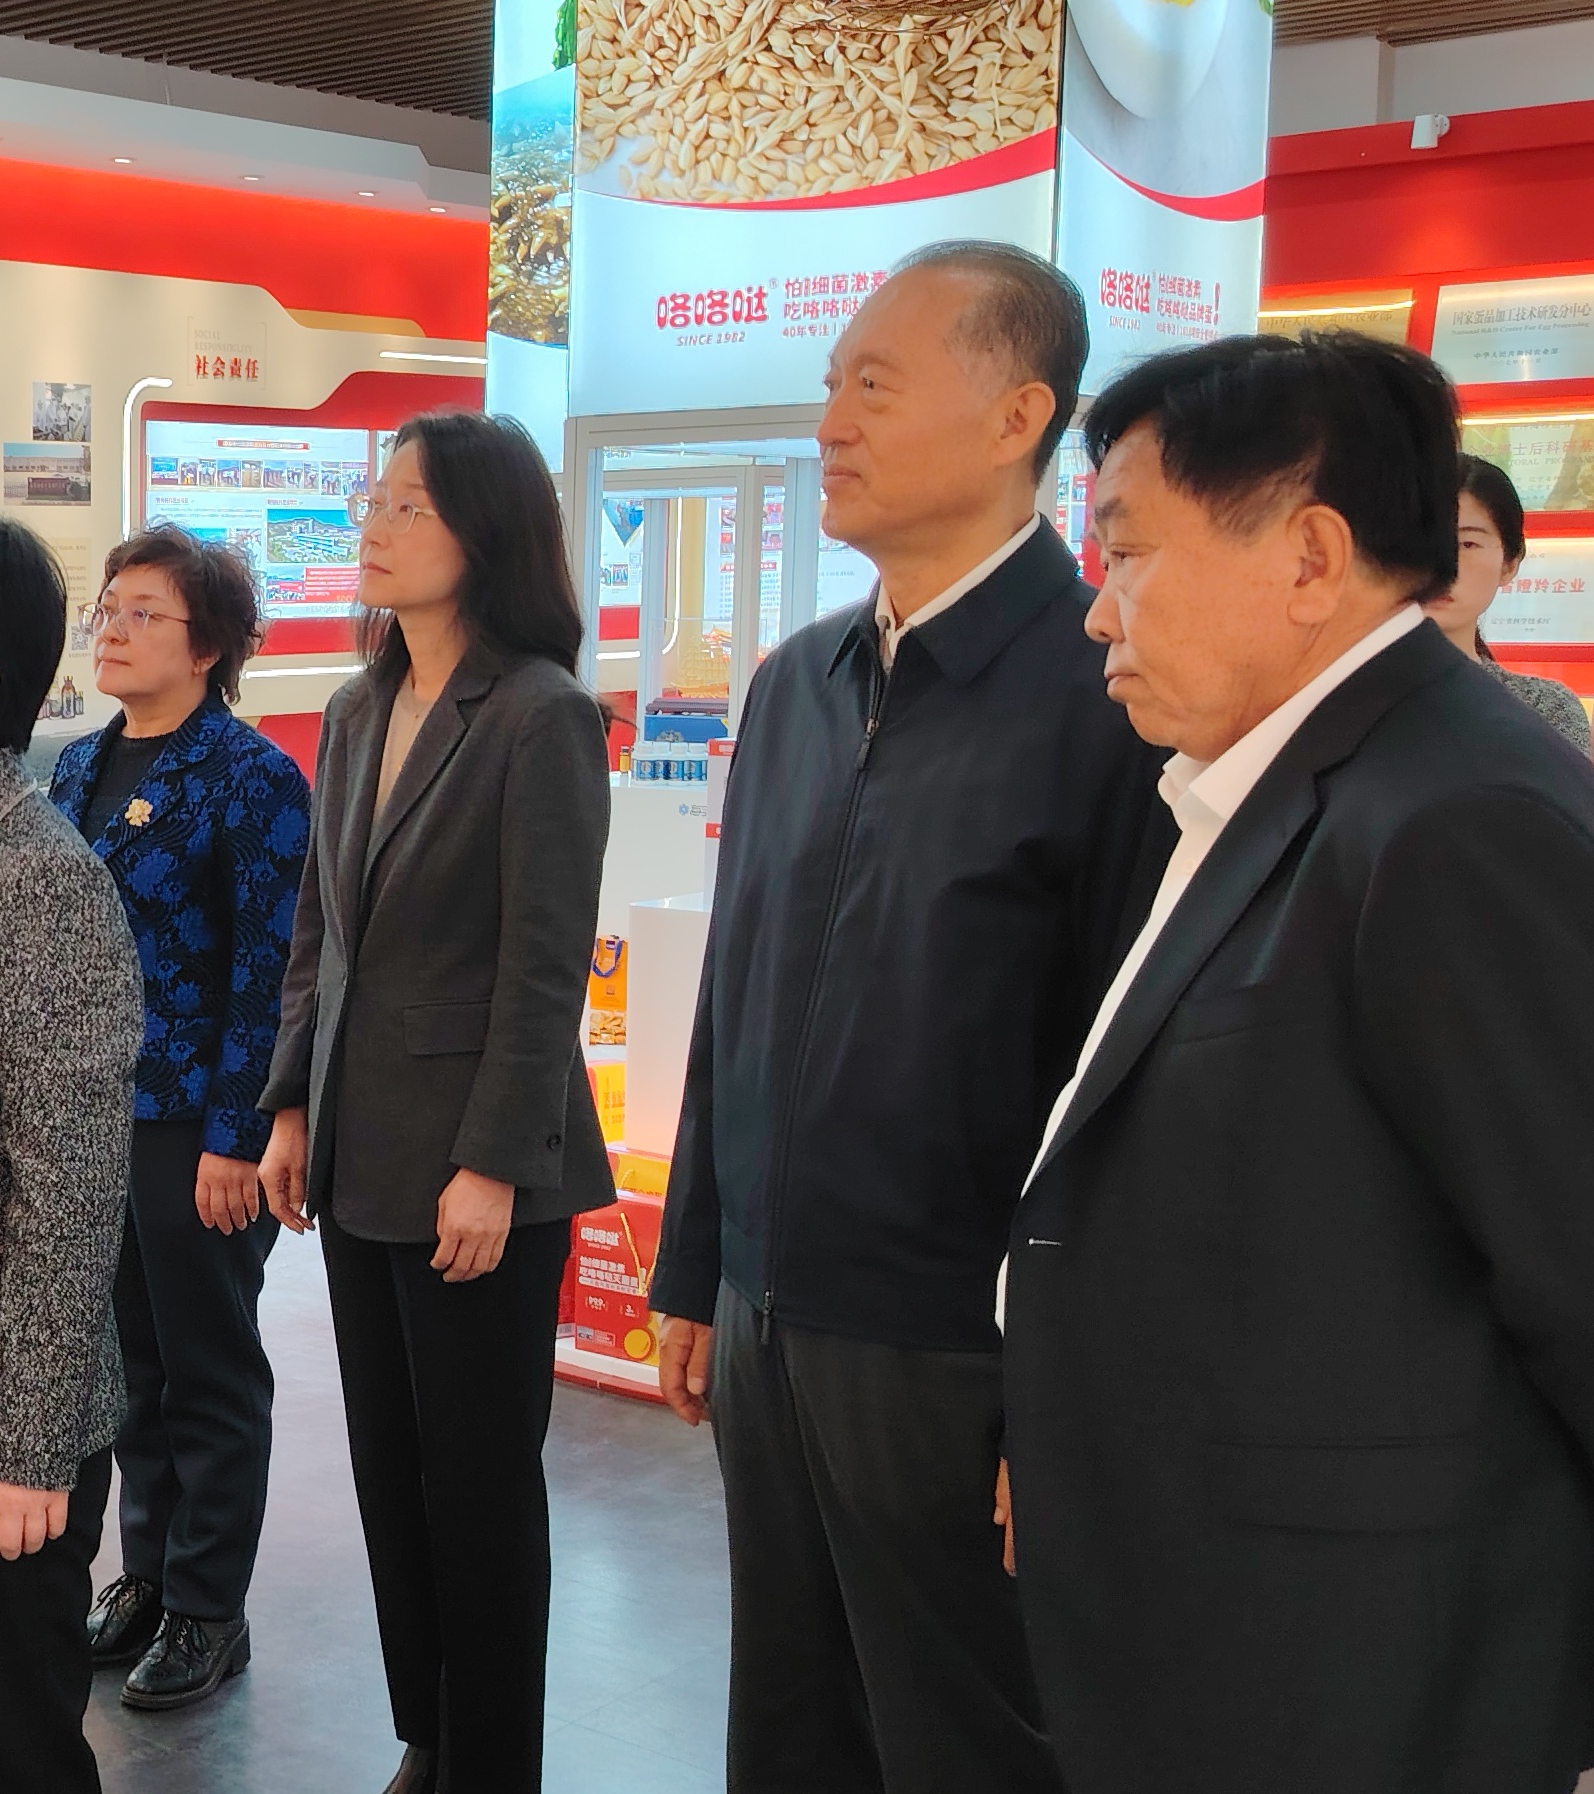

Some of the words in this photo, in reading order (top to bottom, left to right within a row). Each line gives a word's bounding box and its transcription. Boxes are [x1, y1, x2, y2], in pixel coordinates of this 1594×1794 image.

[656, 285, 769, 330] 咯咯哒
[676, 334, 713, 346] SINCE
[716, 332, 746, 344] 1982
[194, 354, 260, 382] 社会责任
